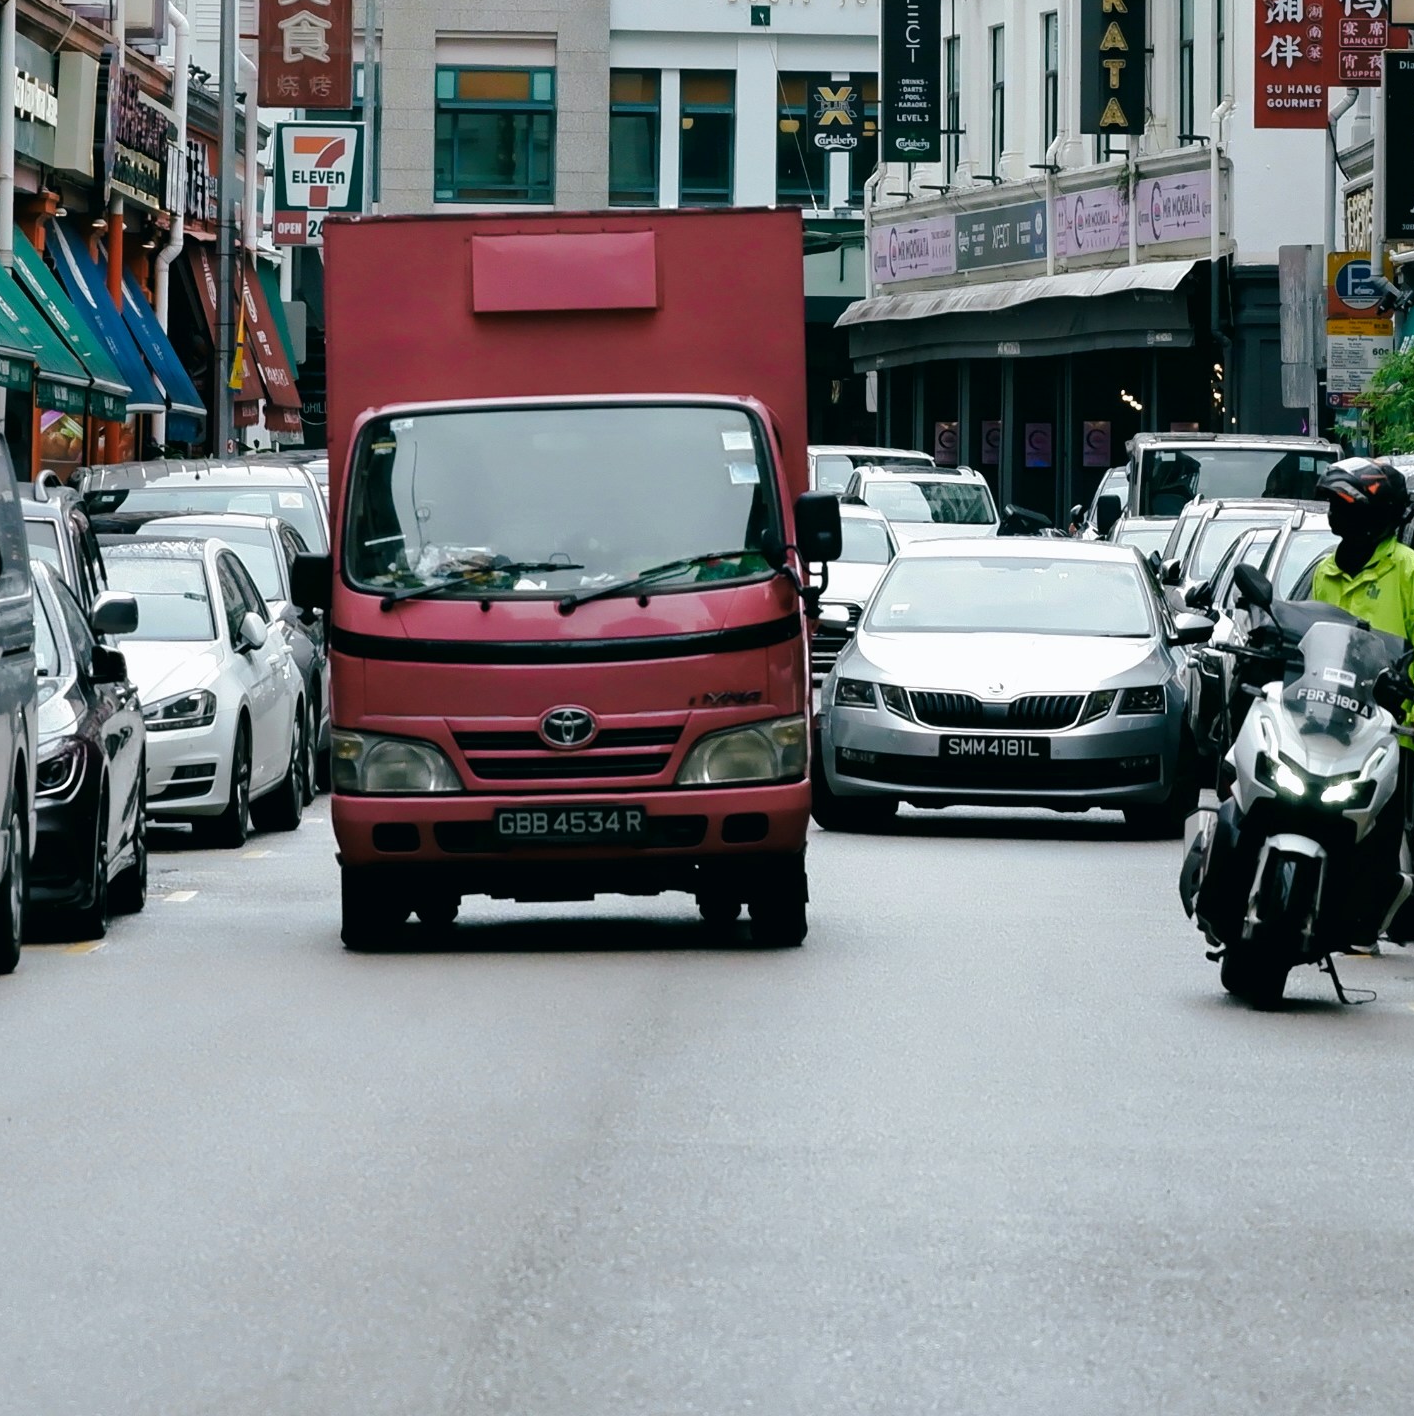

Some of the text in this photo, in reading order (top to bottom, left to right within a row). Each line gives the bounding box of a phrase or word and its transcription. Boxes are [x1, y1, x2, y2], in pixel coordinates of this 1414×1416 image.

[1306, 2, 1323, 62] 湖南菜
[1342, 20, 1385, 35] 宴席
[1343, 37, 1385, 45] BANQUET
[1342, 53, 1382, 68] 宵夜
[277, 74, 331, 97] 烧烤
[1267, 85, 1322, 94] SU HANG
[1266, 98, 1322, 107] GOURMET
[897, 114, 929, 122] LEVEL 3
[814, 133, 857, 150] Carlsberg
[895, 137, 930, 151] Carlsberg
[1172, 193, 1201, 217] MOOKATA
[278, 222, 302, 234] OPEN
[691, 690, 762, 706] YNA
[1296, 688, 1370, 717] FBR 3180 A
[499, 810, 642, 834] GBB 4534 R
